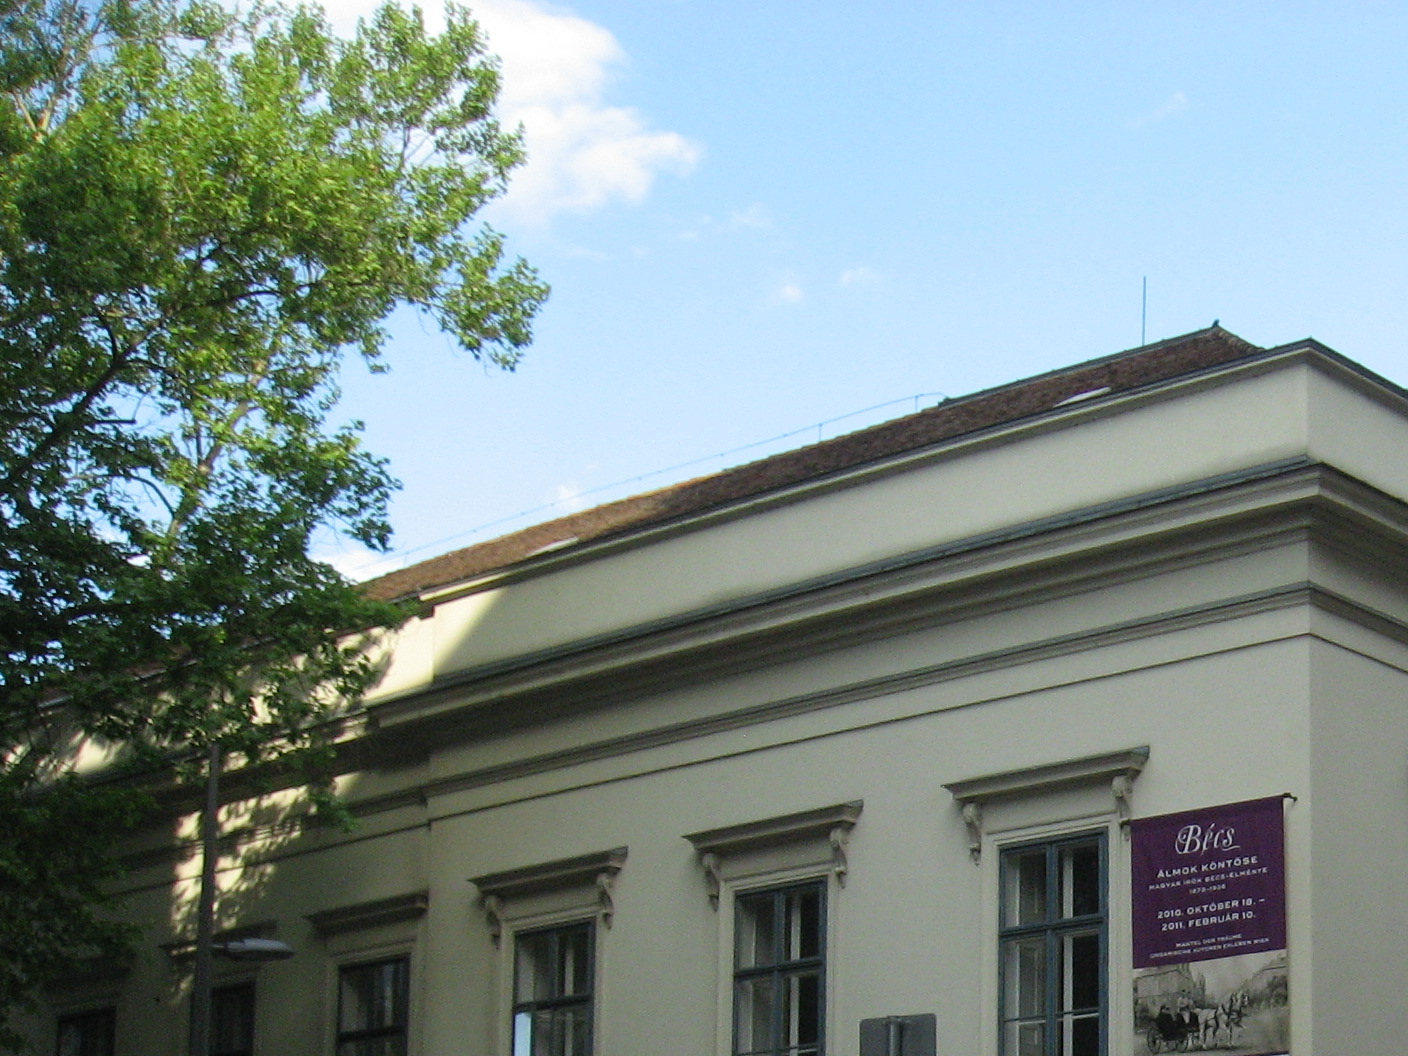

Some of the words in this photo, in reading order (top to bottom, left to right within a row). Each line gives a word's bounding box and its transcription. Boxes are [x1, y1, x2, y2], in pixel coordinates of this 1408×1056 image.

[1175, 823, 1240, 855] Bécs
[1157, 865, 1198, 878] ÁLMOK
[1202, 856, 1258, 871] KÖNTÖSE
[1187, 900, 1239, 915] OKTÓBER
[1188, 912, 1239, 927] FEBRUÁR
